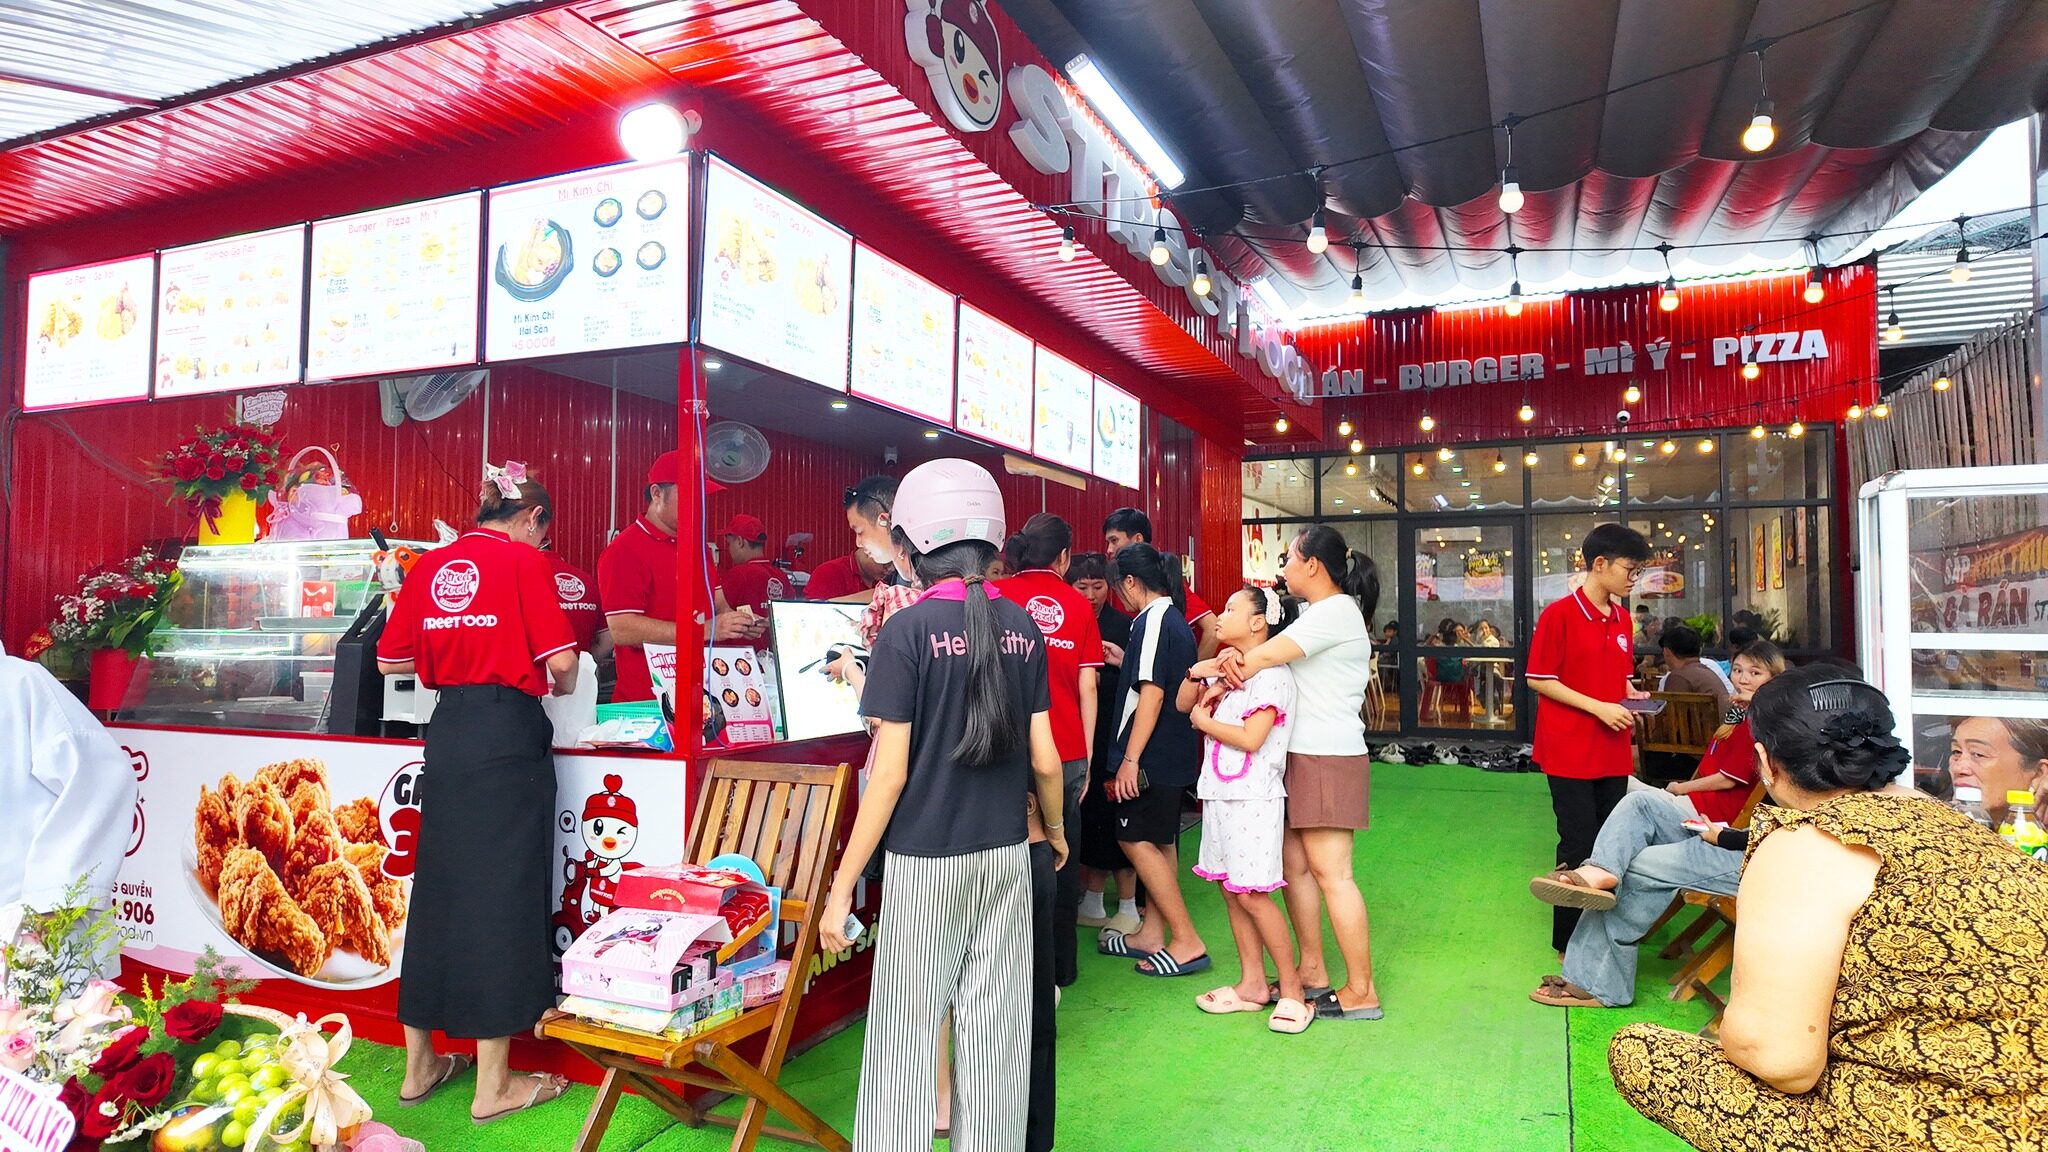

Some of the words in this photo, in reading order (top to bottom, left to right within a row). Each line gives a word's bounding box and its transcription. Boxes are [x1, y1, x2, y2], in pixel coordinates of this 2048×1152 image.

[1321, 367, 1364, 398] ÁN
[1400, 352, 1545, 391] BURGER
[1585, 339, 1634, 376] MÌ
[1645, 336, 1672, 371] Ý
[1713, 329, 1830, 367] PIZZA
[437, 567, 475, 586] Street
[437, 581, 470, 596] Food
[1977, 578, 2030, 628] RÁN
[930, 630, 969, 659] Hel
[1049, 637, 1075, 650] FOOD
[121, 879, 153, 898] QUYỀN
